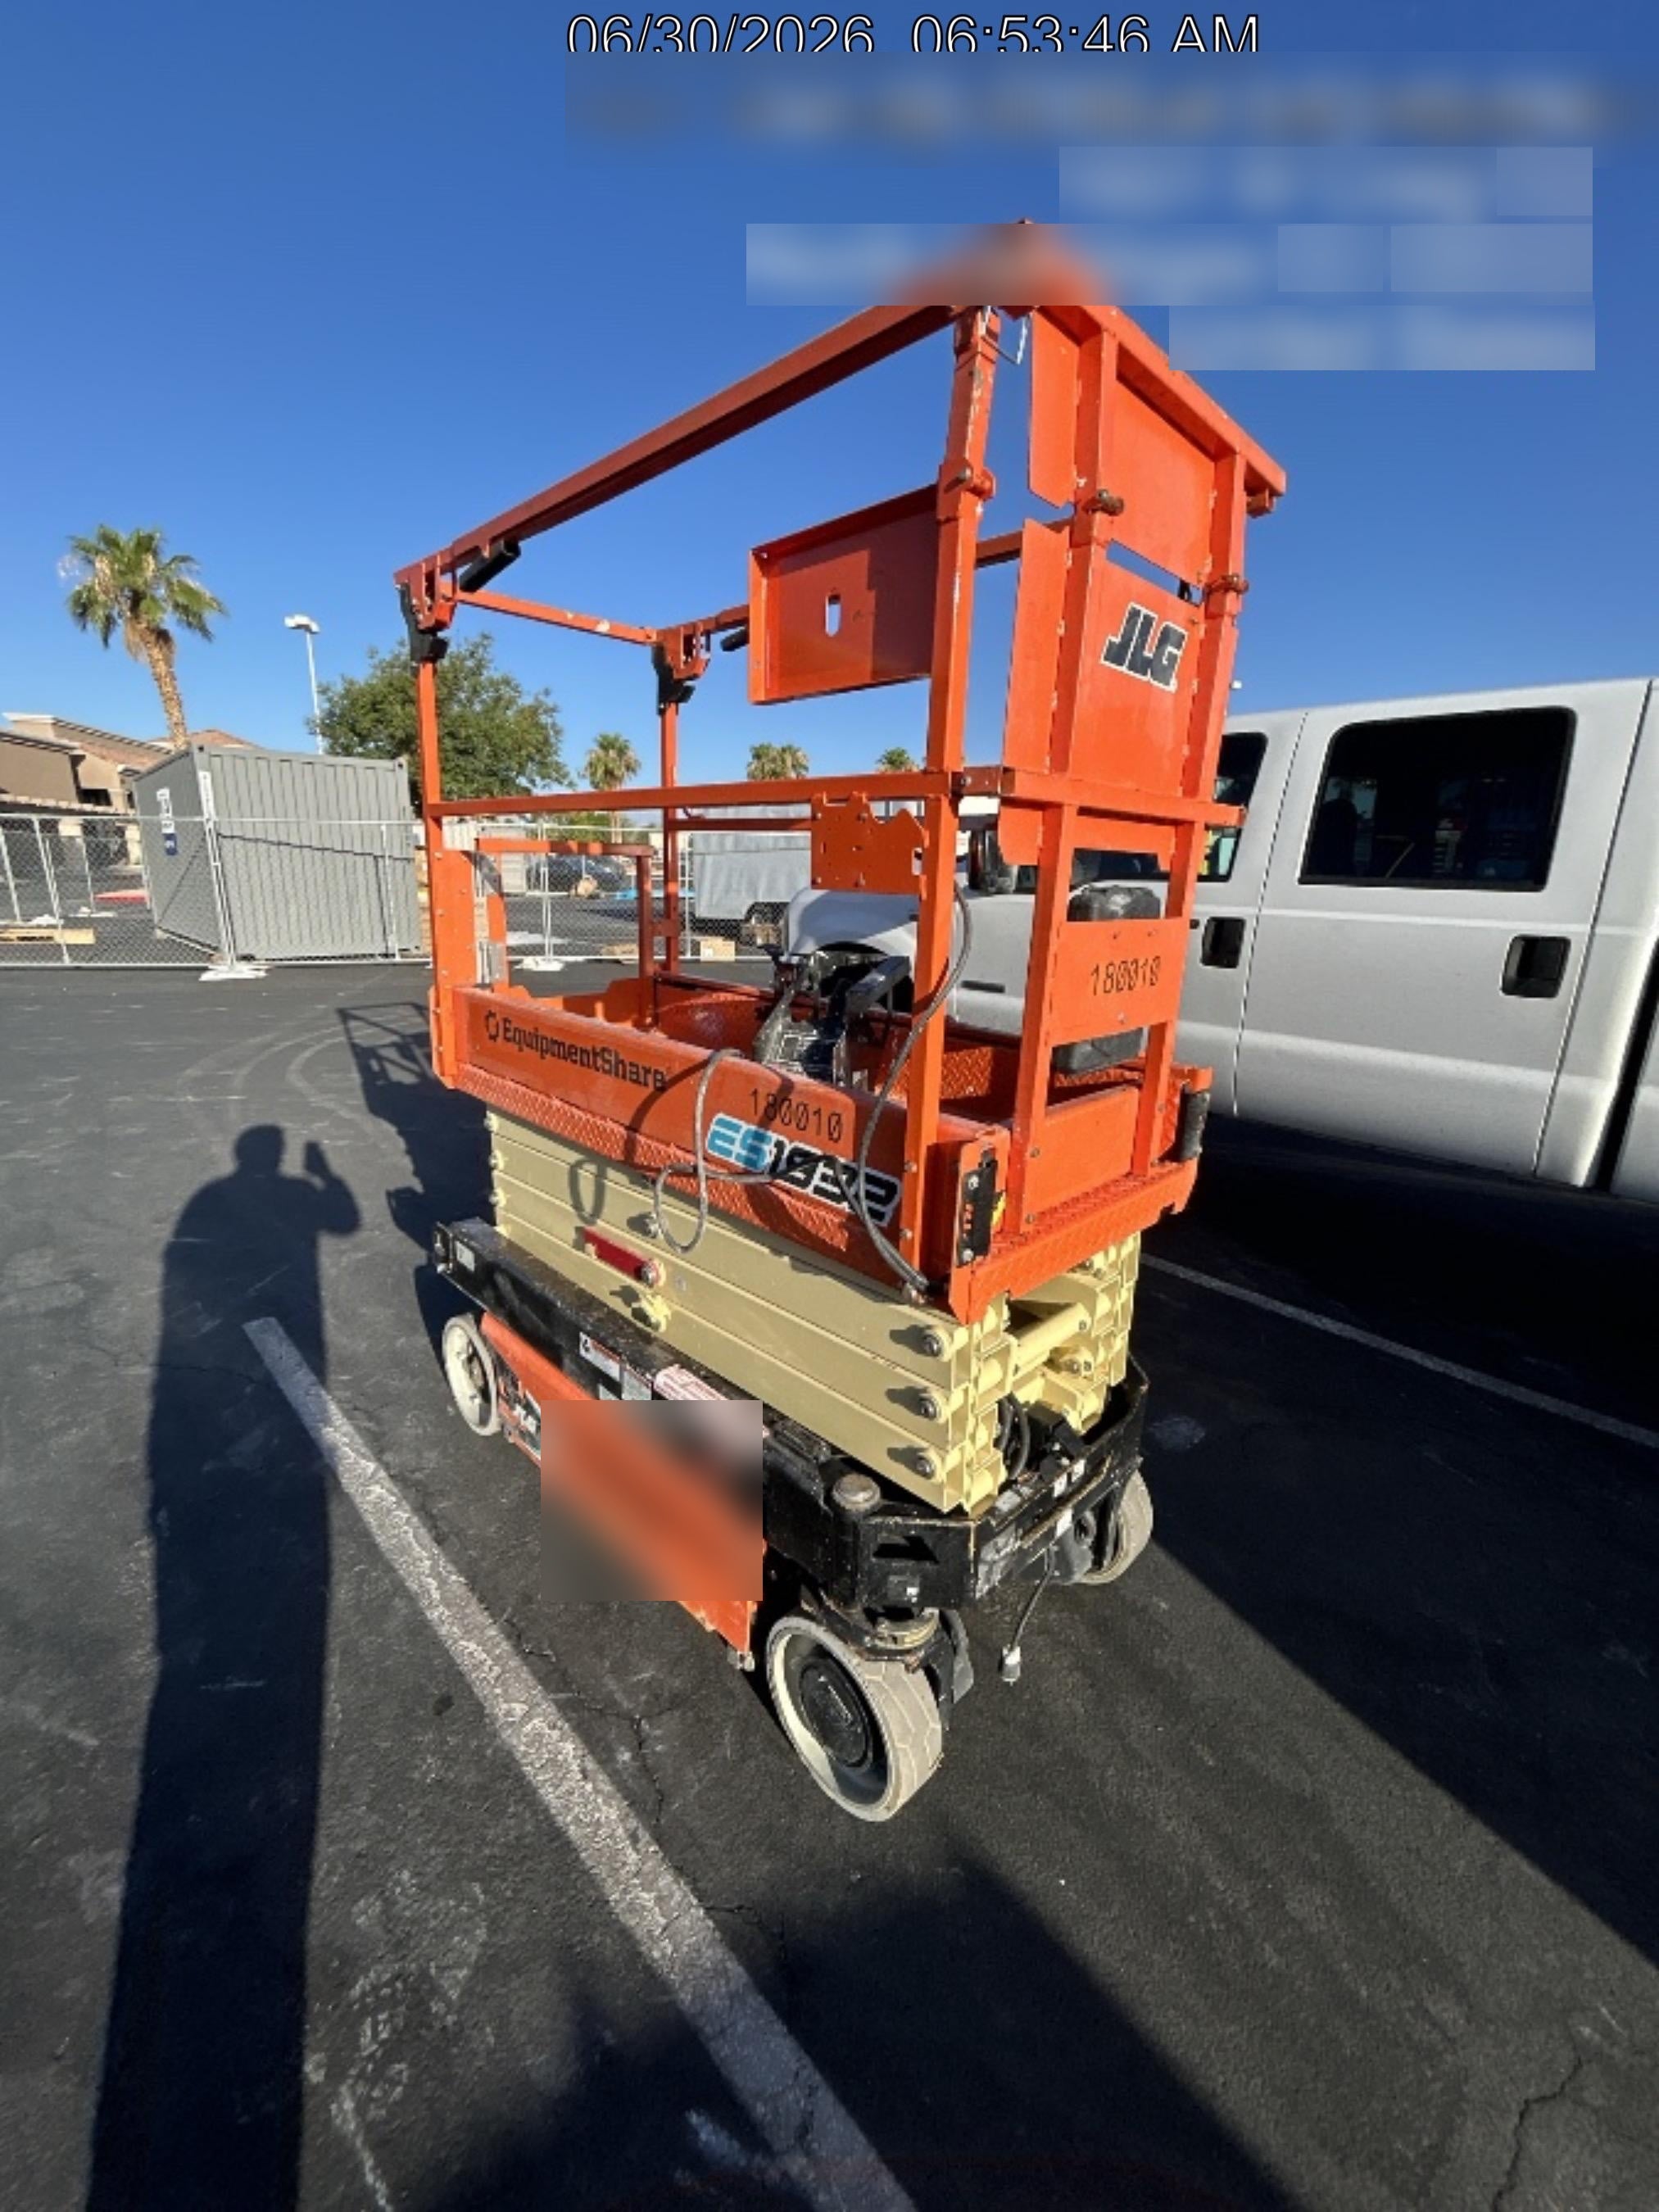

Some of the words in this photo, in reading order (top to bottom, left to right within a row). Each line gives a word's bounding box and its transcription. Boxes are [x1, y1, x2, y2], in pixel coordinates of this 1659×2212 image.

[1100, 602, 1188, 693] JLG
[1090, 954, 1161, 996] 180010
[501, 1016, 668, 1092] EquipmentShare
[749, 1087, 843, 1144] 180010
